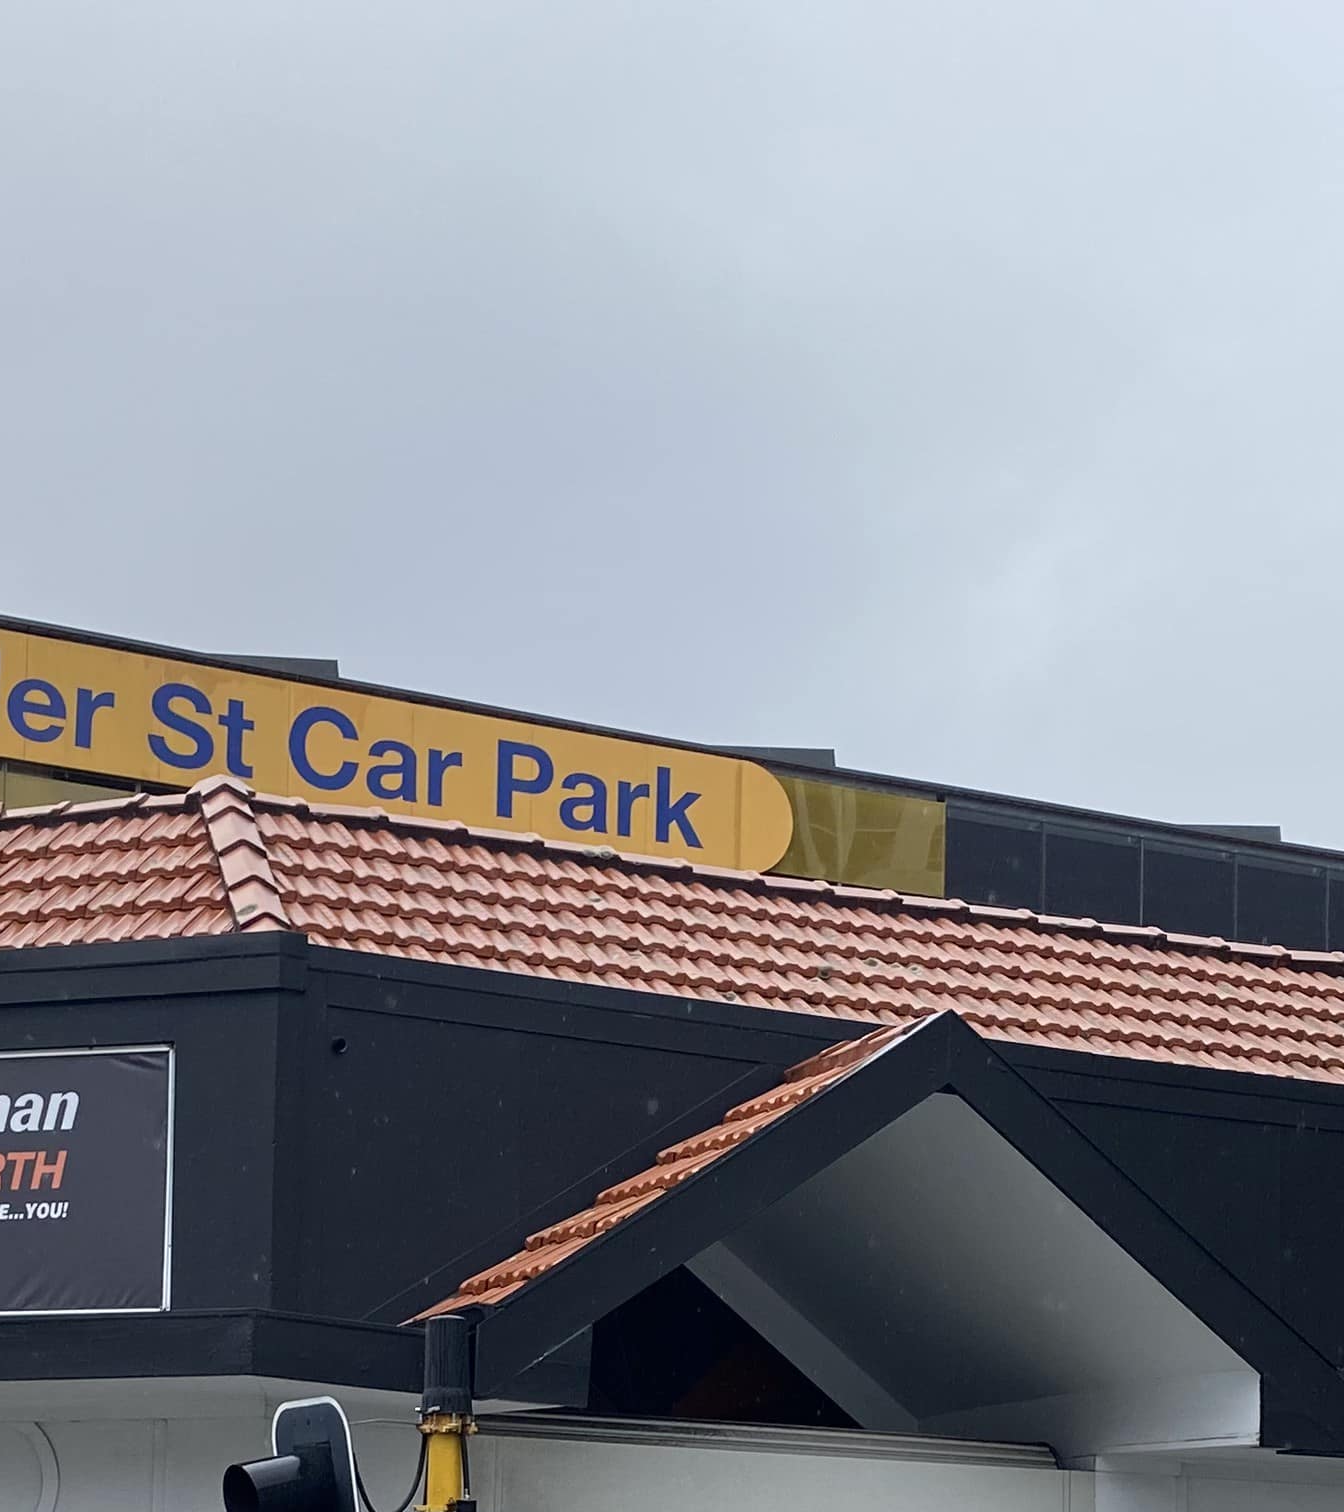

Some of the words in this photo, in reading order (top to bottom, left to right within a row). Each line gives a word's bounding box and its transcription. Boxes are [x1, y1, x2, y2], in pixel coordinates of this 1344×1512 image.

[147, 682, 255, 779] St
[288, 706, 463, 808] Car
[494, 740, 704, 850] Park
